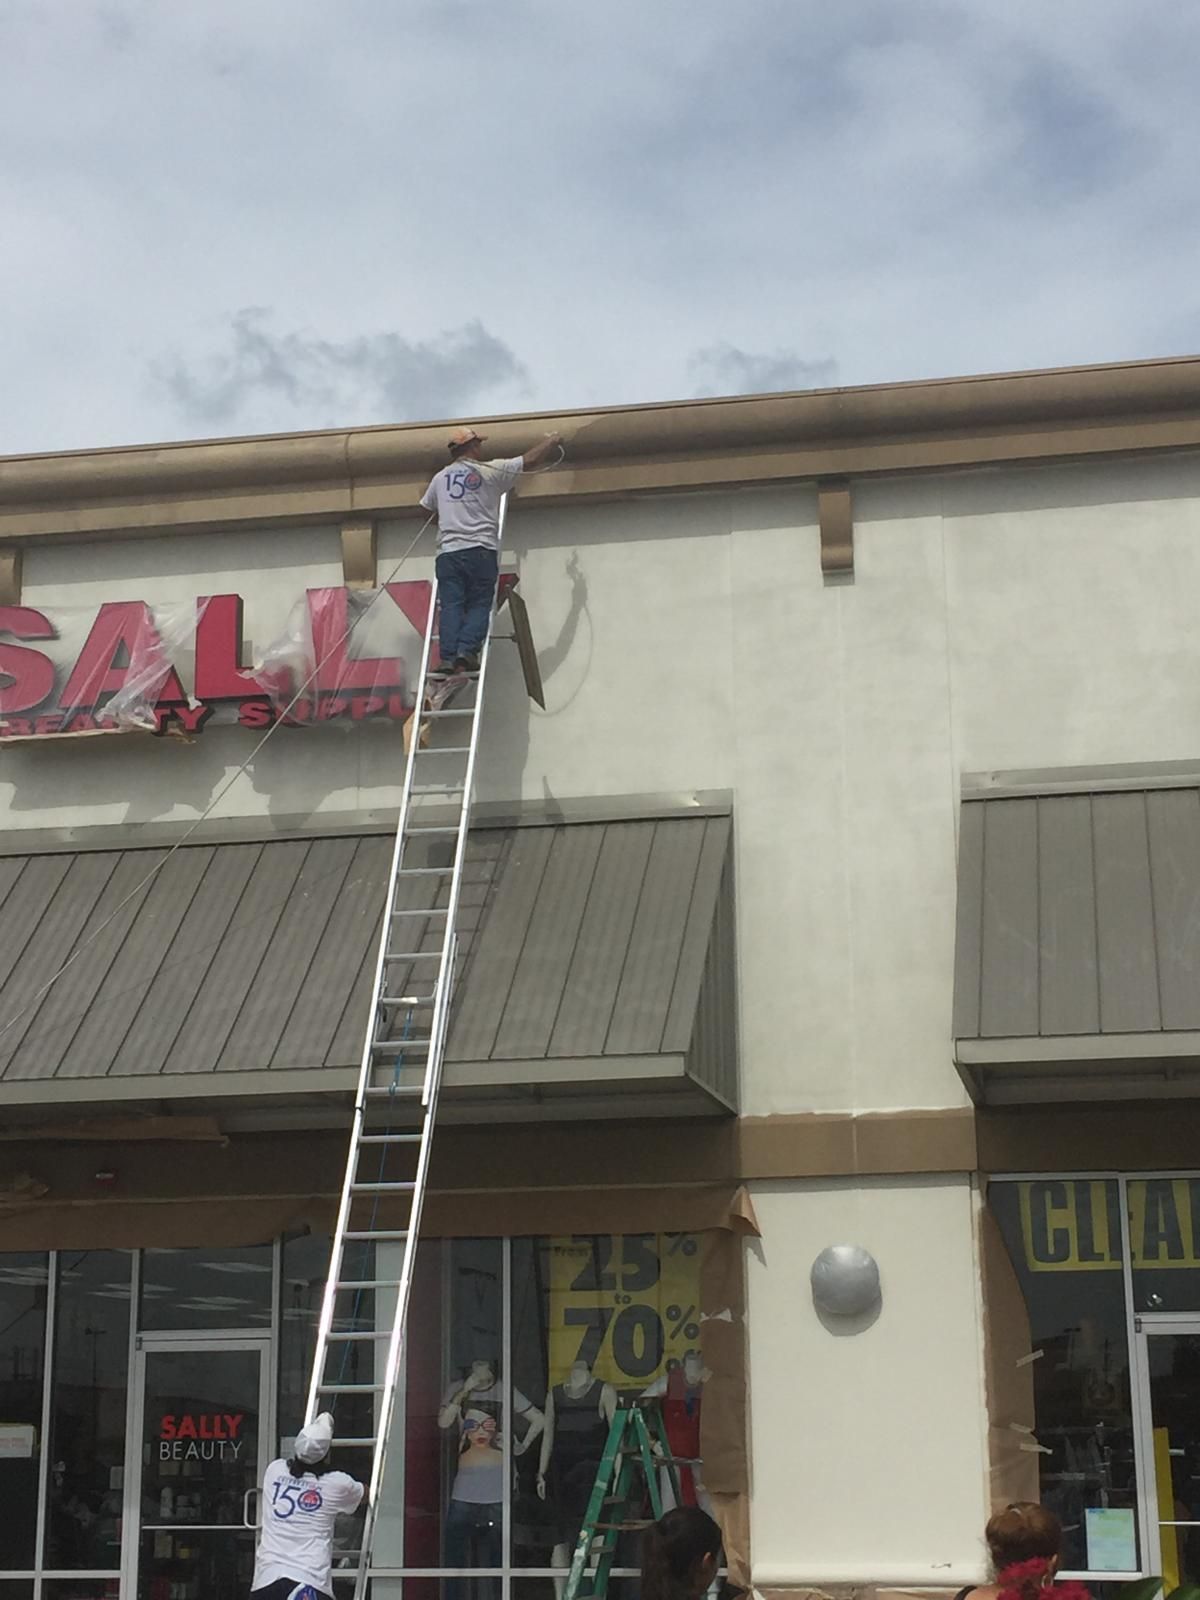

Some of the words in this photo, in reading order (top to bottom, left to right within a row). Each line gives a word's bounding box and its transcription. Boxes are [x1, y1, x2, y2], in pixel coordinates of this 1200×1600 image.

[614, 1293, 632, 1304] to
[564, 1304, 700, 1377] 70%
[160, 1414, 243, 1440] SALLY
[160, 1441, 242, 1461] BEAUTY
